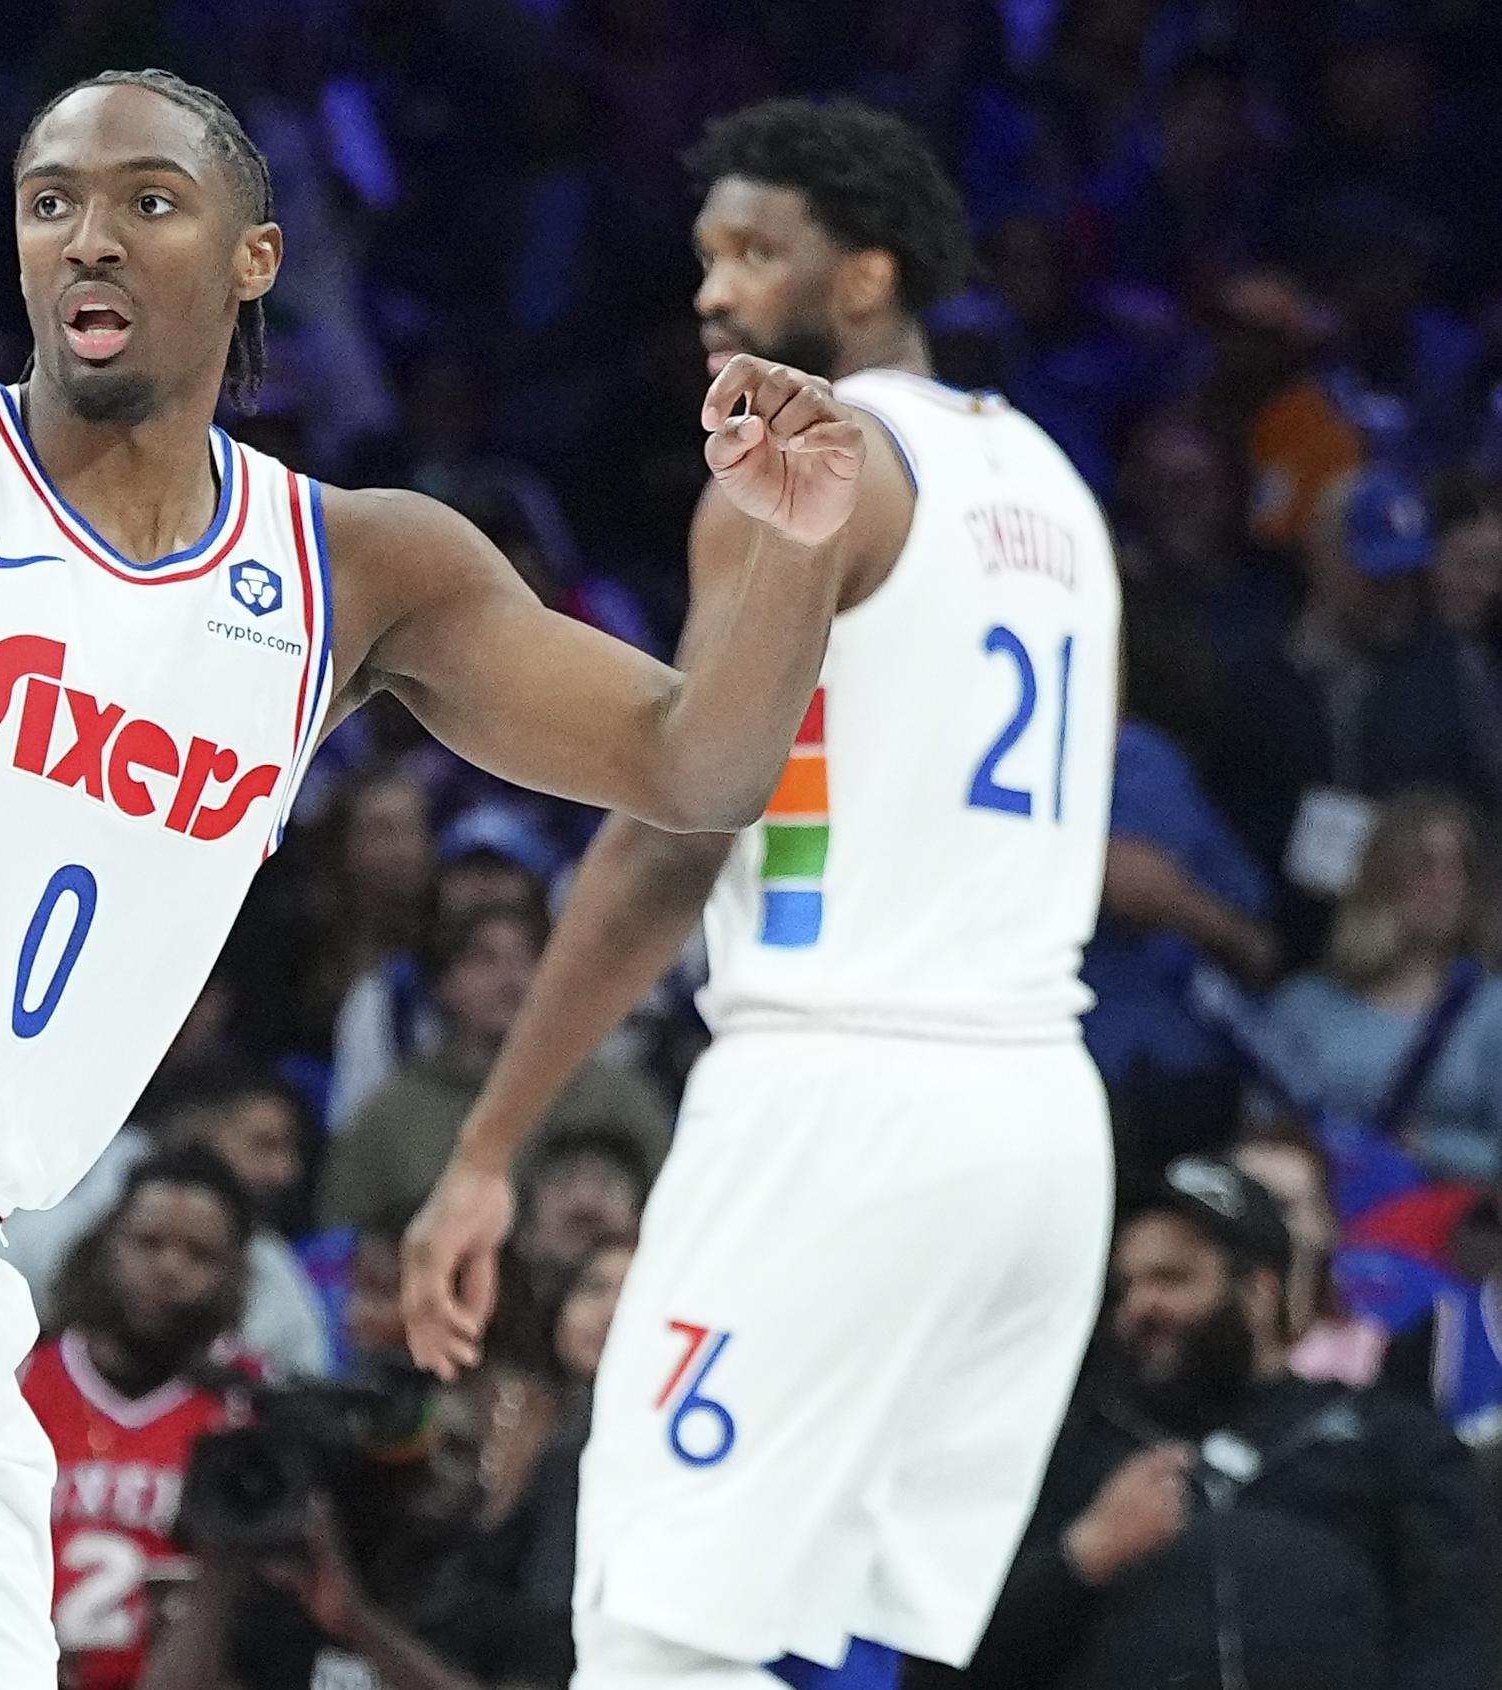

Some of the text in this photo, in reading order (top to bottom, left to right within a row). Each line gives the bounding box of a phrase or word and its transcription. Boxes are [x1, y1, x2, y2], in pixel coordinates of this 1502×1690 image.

[206, 619, 302, 656] crypto.com
[967, 626, 1072, 823] 21
[11, 864, 98, 1039] 0
[656, 1319, 735, 1467] 76
